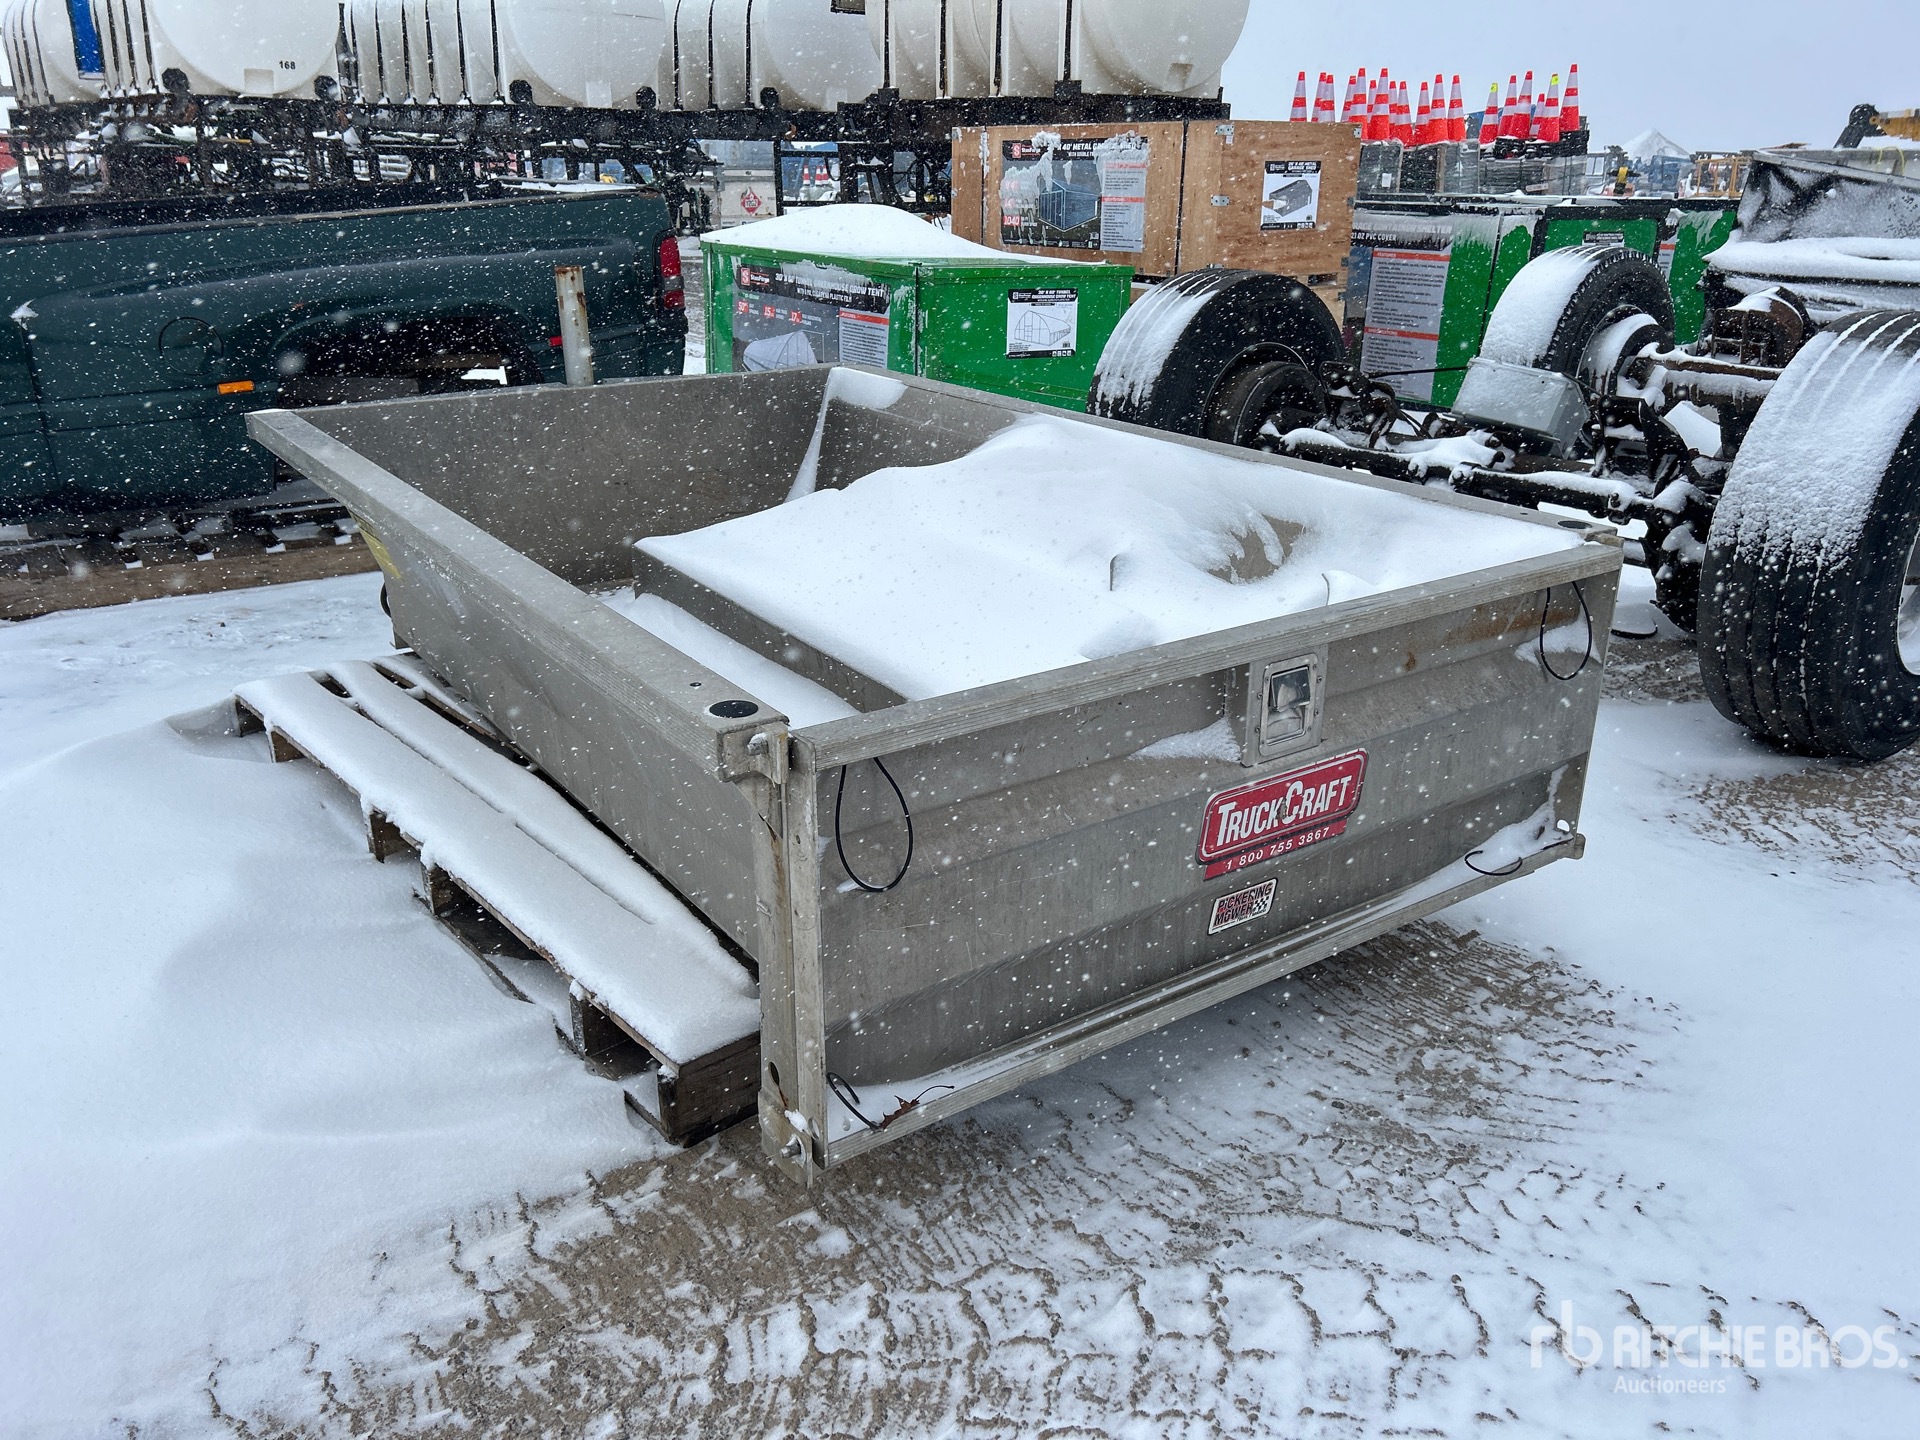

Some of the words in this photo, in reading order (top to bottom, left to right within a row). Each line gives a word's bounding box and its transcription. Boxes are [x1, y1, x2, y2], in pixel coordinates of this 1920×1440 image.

[279, 61, 296, 70] 168
[1073, 143, 1092, 151] METAL
[1365, 232, 1377, 241] PVC
[1377, 233, 1397, 242] COVER
[867, 287, 885, 298] TENT
[1227, 859, 1233, 871] 1
[1238, 849, 1264, 867] 800
[1269, 840, 1294, 857] 755
[1298, 827, 1330, 847] 3867
[1217, 882, 1274, 912] PICKERING
[1213, 901, 1255, 926] MOWER
